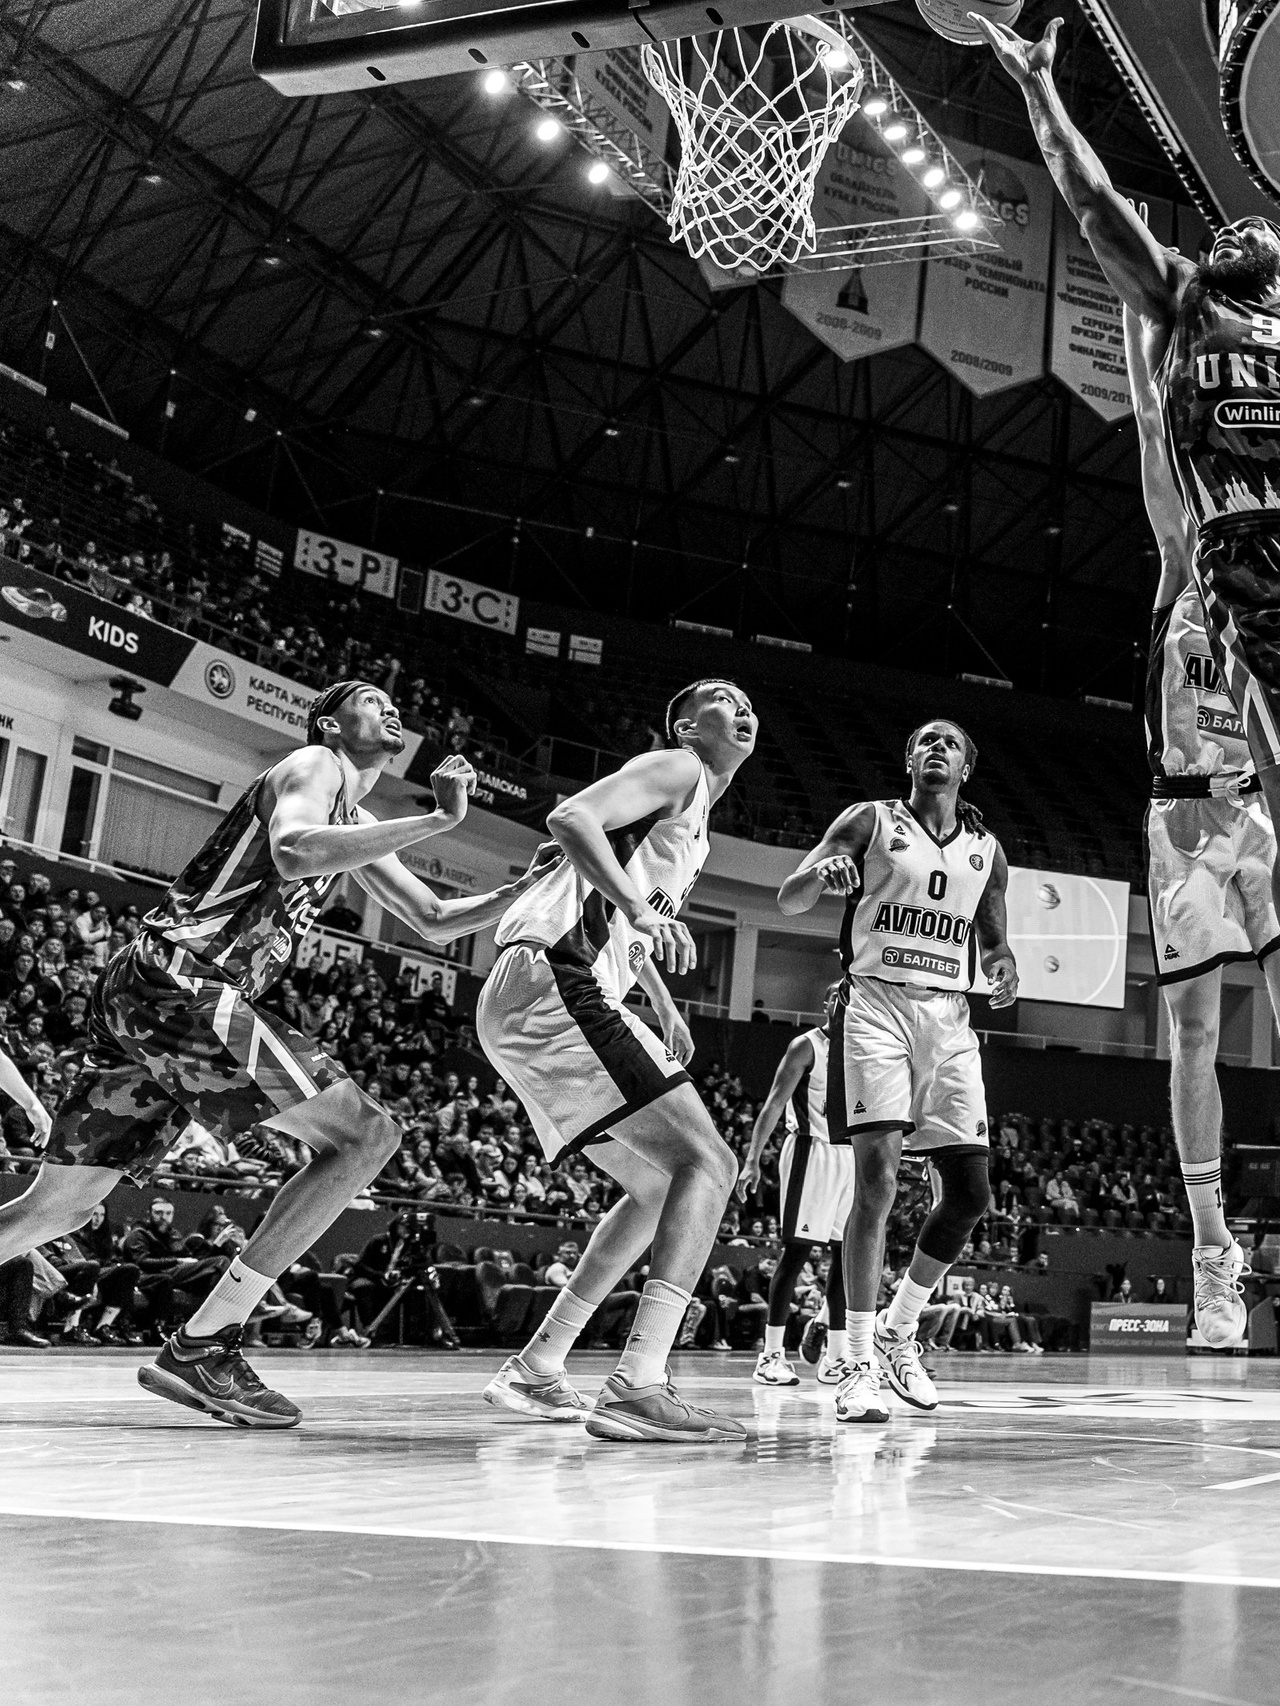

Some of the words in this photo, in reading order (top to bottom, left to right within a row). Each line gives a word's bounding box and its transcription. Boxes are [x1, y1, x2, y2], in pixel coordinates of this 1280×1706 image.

[1080, 382, 1132, 406] 2009/201
[89, 616, 139, 654] KIDS
[249, 676, 288, 701] КАРТА
[927, 869, 948, 901] 0
[870, 901, 972, 947] AVTODO
[903, 953, 960, 975] БАЛТБЕТ
[1108, 1318, 1169, 1332] ПРЕСС-ЗОНА
